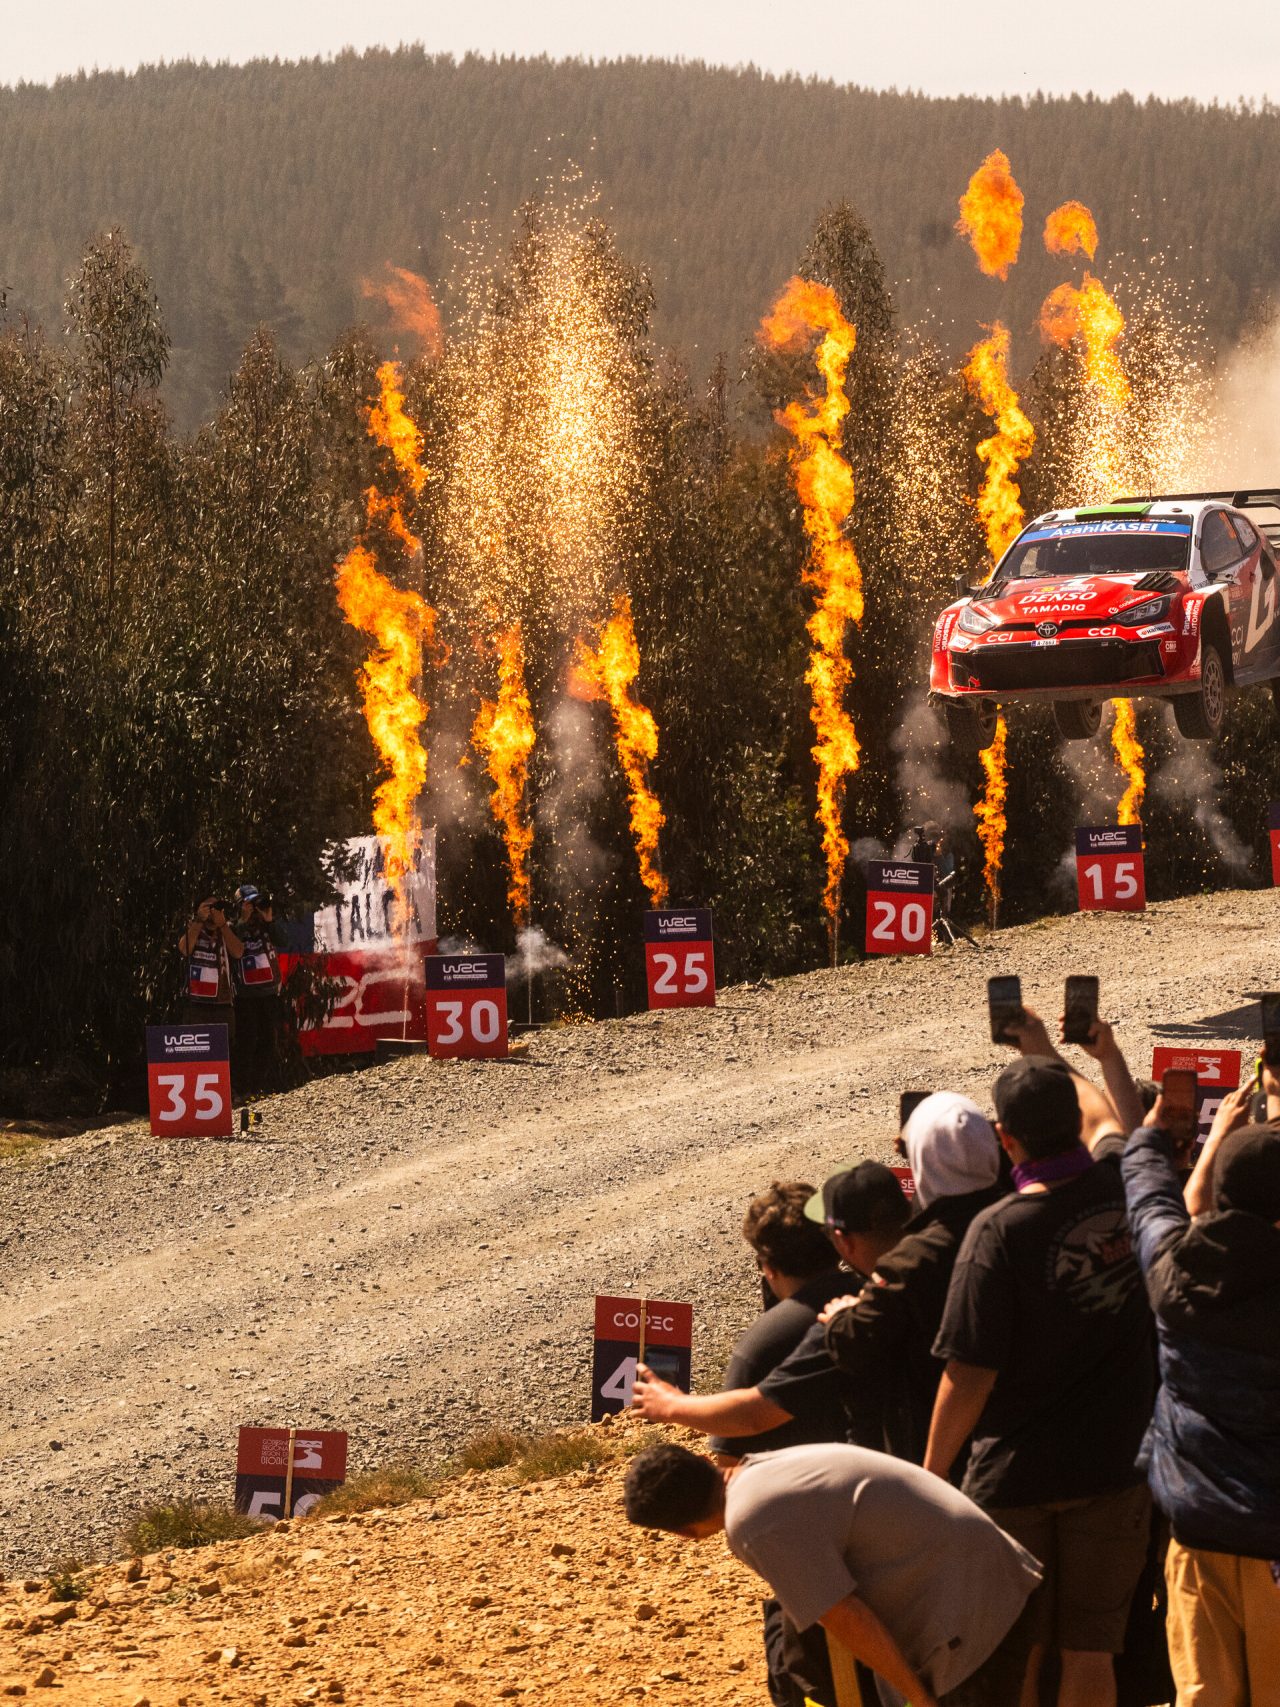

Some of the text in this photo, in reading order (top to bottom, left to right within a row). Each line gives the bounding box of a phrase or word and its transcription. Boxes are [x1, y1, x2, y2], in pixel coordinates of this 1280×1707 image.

[1018, 592, 1098, 604] DENSO
[1022, 604, 1086, 615] TAMADIC
[1088, 628, 1116, 636] CCI
[986, 633, 1014, 643] CCI
[1089, 831, 1127, 841] WRC
[882, 868, 919, 879] WRC
[1084, 862, 1138, 900] 15
[659, 917, 697, 927] WRC
[872, 901, 926, 942] 20
[443, 963, 487, 973] WRC
[652, 952, 708, 994] 25
[436, 1000, 500, 1044] 30
[164, 1033, 210, 1046] WRC
[158, 1074, 223, 1121] 35
